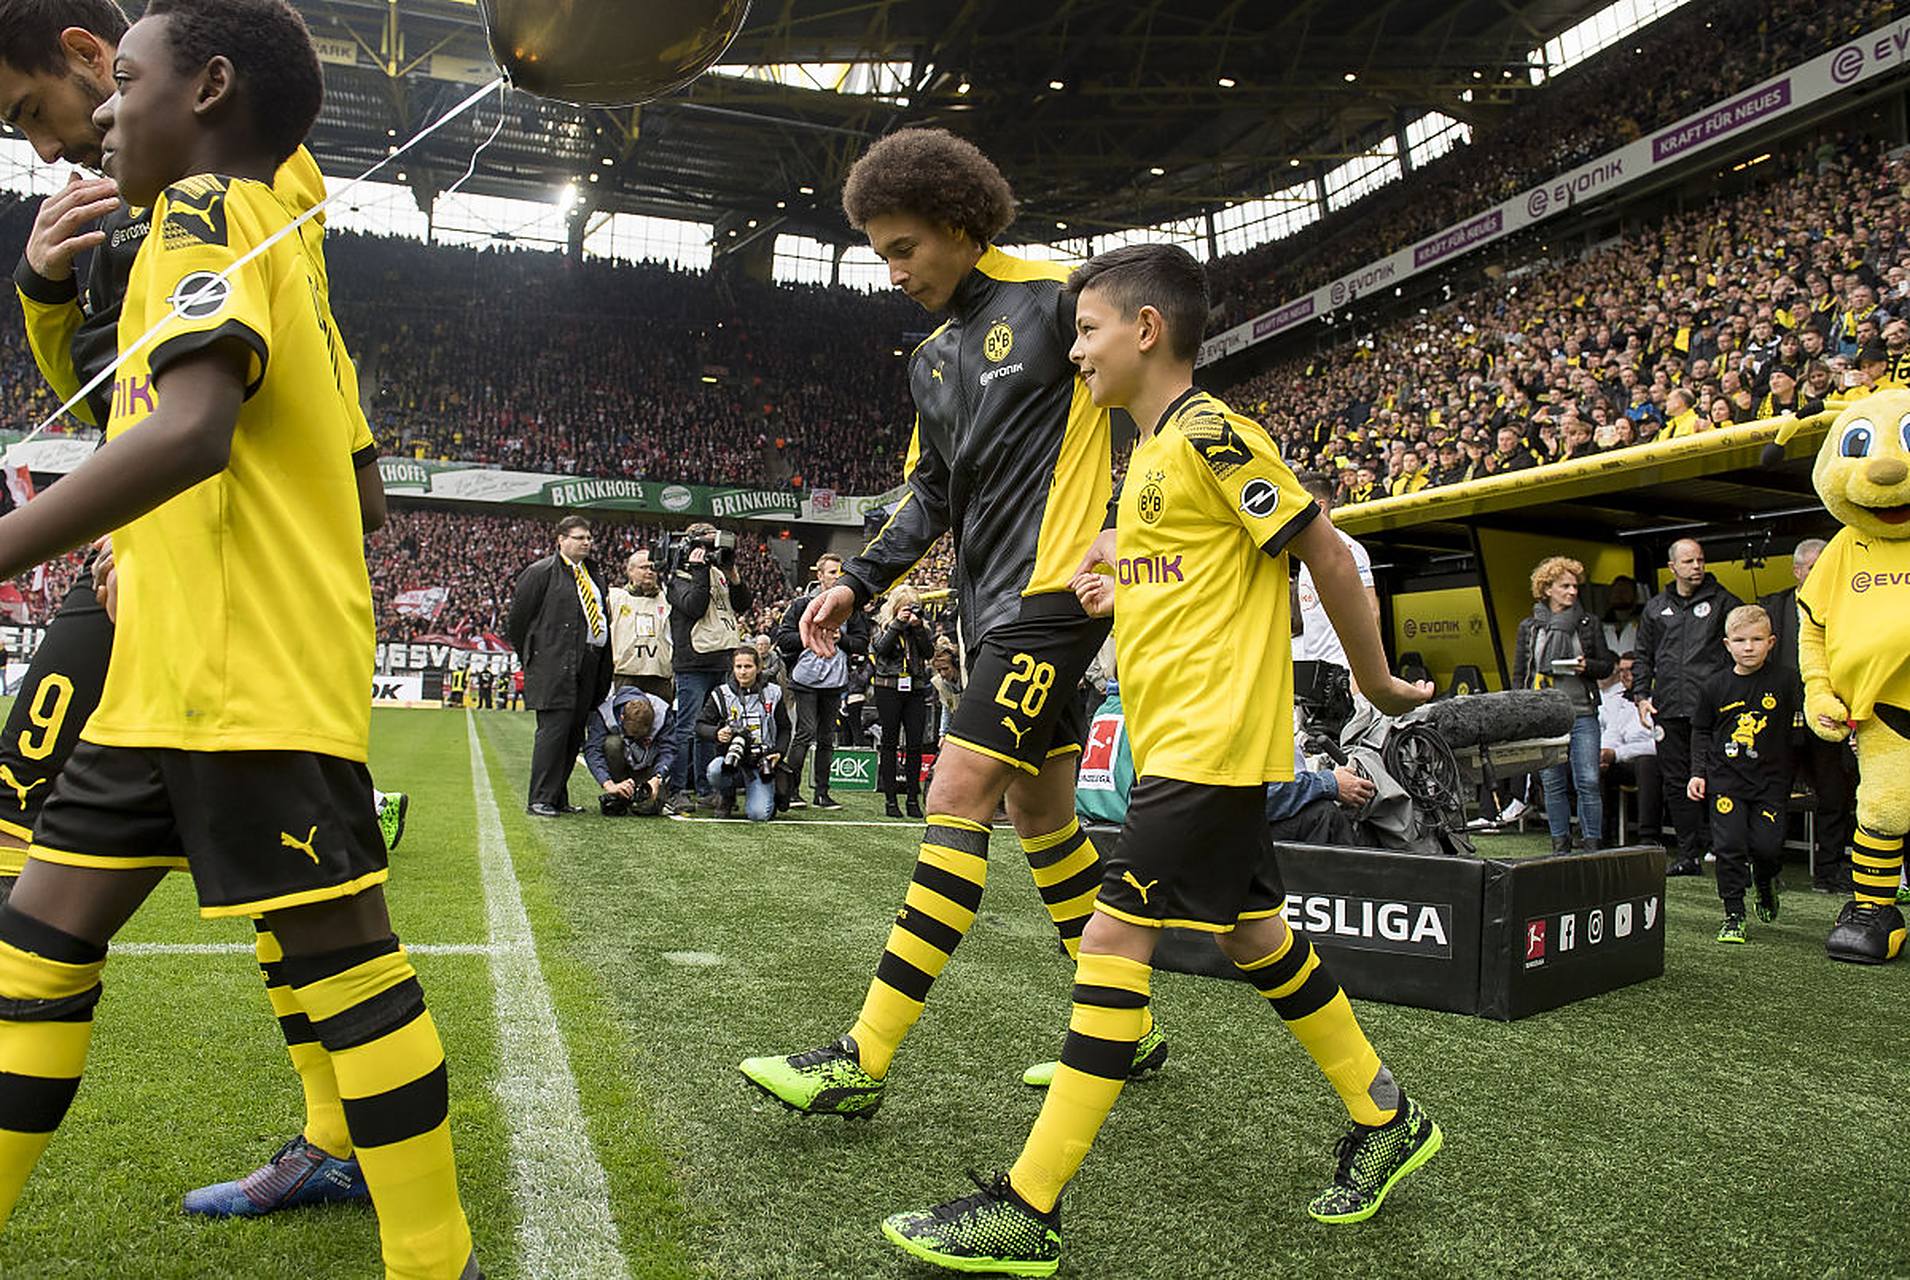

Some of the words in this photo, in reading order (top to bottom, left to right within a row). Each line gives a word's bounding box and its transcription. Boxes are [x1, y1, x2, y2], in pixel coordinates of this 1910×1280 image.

[1660, 124, 1703, 154] KRAFT
[1705, 112, 1733, 134] FÜR
[1735, 89, 1782, 121] NEUES
[1553, 158, 1623, 202] EVONIK
[1348, 262, 1395, 294] EVONIK
[986, 362, 1024, 380] EVONIK
[1420, 620, 1460, 633] EVONIK
[634, 645, 658, 658] TV
[995, 653, 1056, 718] 28
[18, 673, 75, 760] 9
